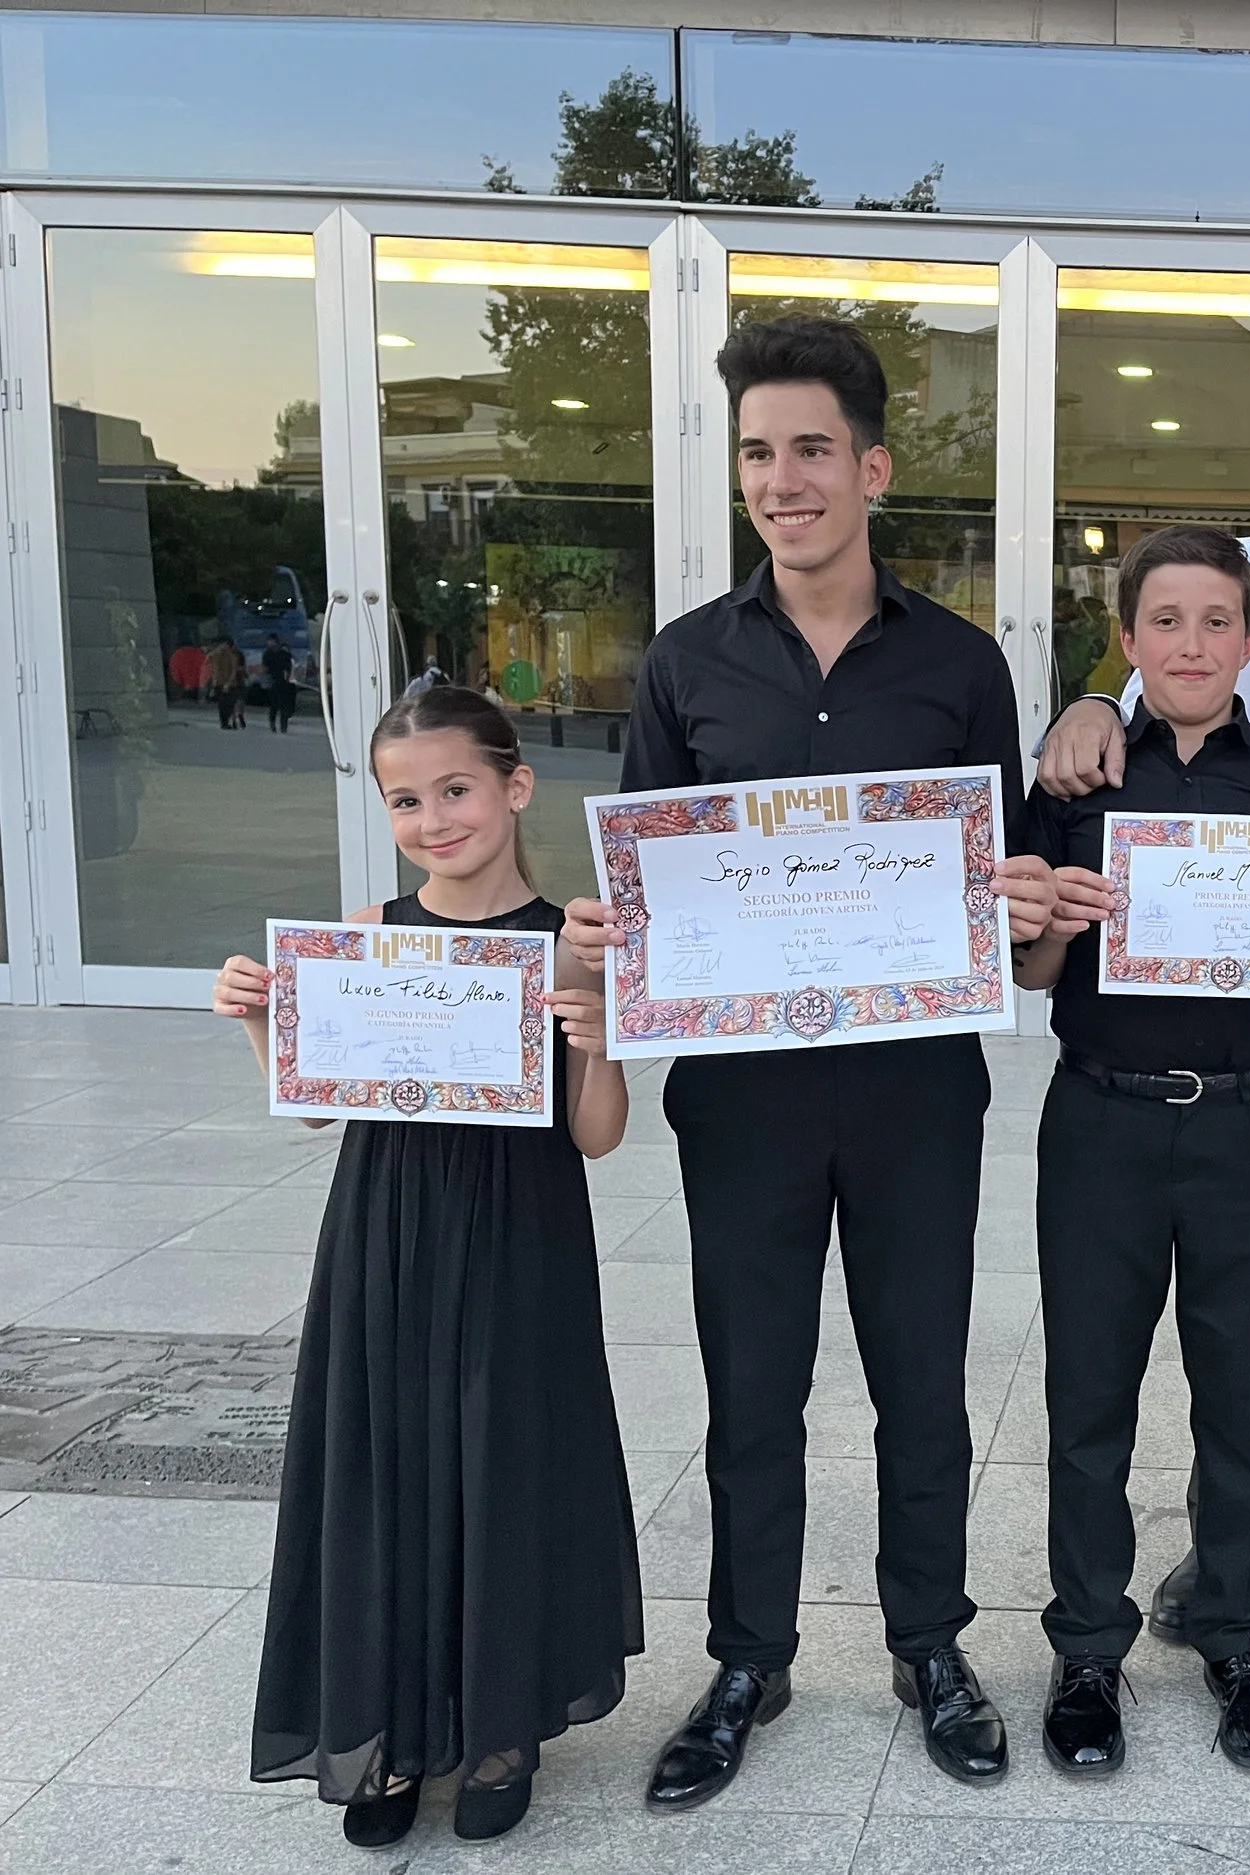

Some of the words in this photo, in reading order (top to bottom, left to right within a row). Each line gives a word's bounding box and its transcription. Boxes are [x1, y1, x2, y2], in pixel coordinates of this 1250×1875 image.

[800, 826, 851, 835] COMPETITION
[700, 850, 770, 891] Sergio
[744, 892, 812, 907] SEGUNDO
[816, 889, 871, 903] PREMIO
[1194, 892, 1230, 901] PRIMER
[738, 907, 798, 919] CATEGORÍA
[800, 906, 834, 917] JOVEN
[836, 904, 879, 914] ARTISTA
[793, 927, 826, 935] JURADO
[365, 1009, 413, 1020] SEGUNDO
[415, 1011, 455, 1021] PREMIO
